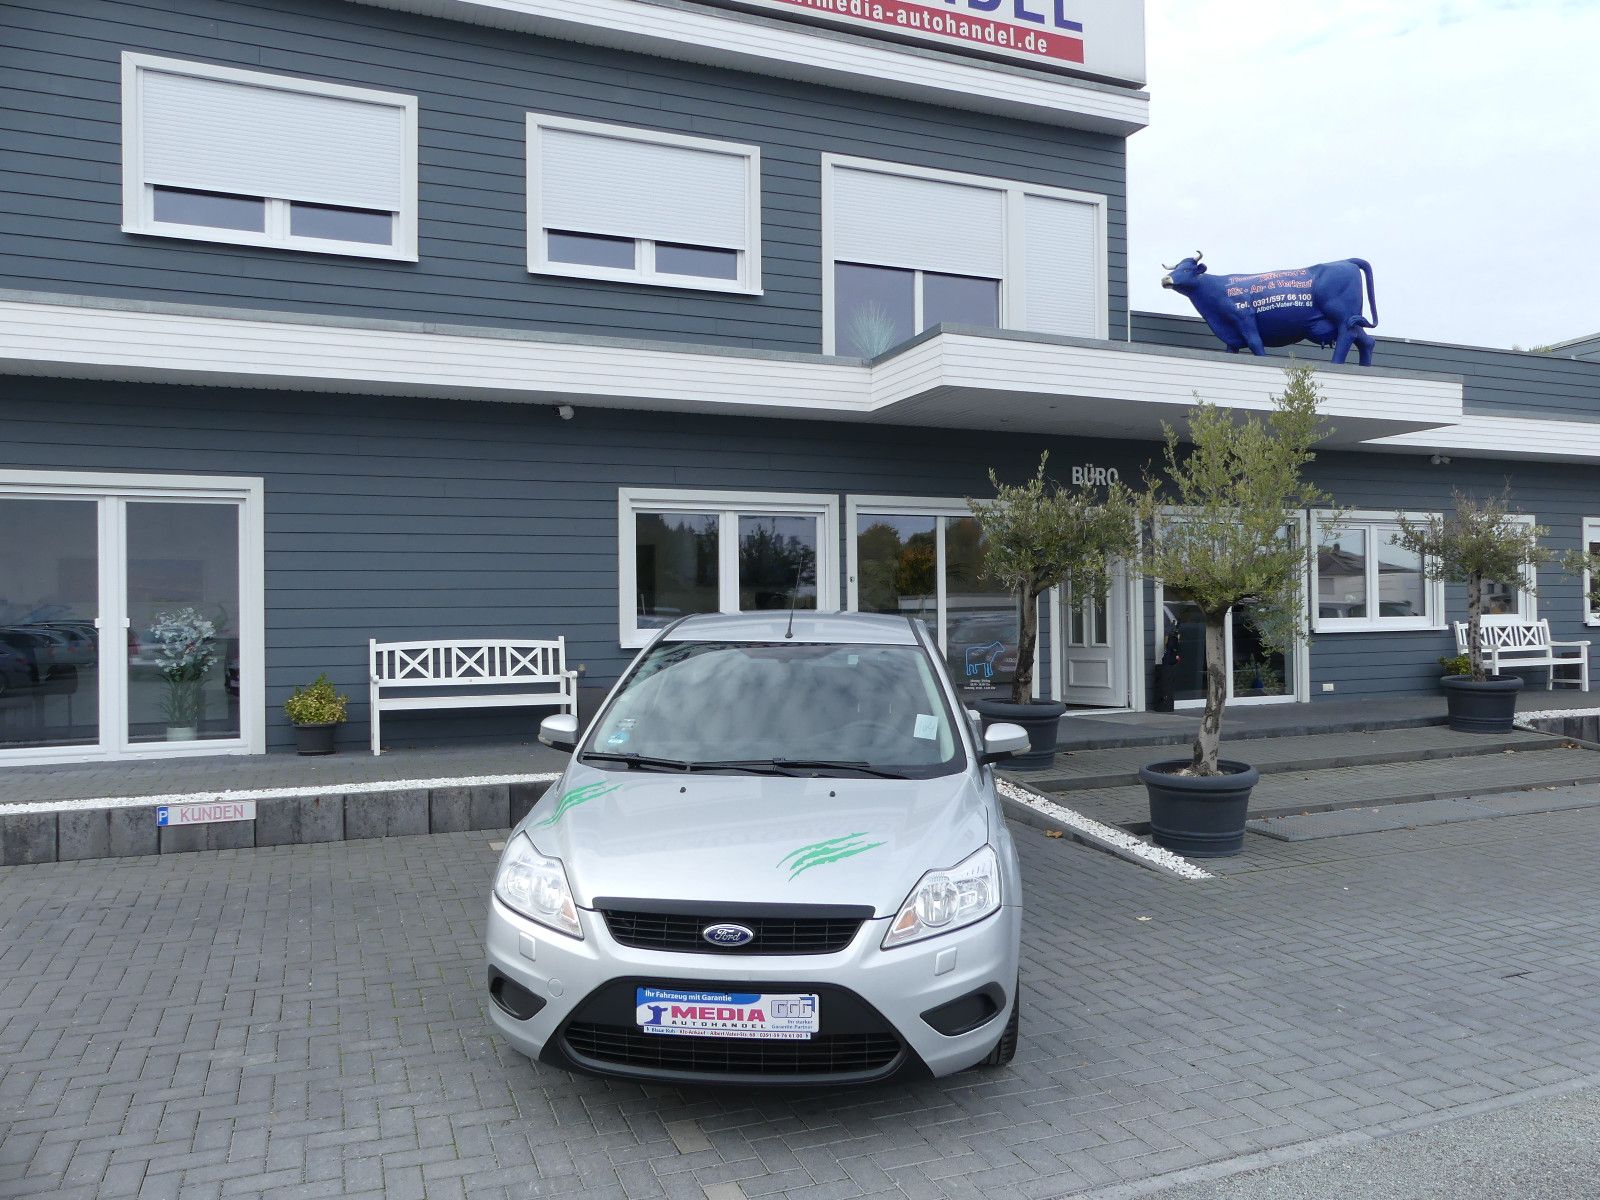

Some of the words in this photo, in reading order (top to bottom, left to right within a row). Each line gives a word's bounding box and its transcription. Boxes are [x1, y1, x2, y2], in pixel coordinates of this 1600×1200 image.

[1235, 301, 1250, 309] Tel.
[1298, 293, 1312, 301] 100
[1072, 463, 1119, 486] BÜRO
[159, 810, 168, 822] P
[180, 804, 244, 822] KUNDEN
[714, 928, 742, 941] Ford
[645, 989, 654, 997] Ihr
[655, 991, 687, 1001] Fahrzeug
[701, 994, 732, 1002] Garantie
[671, 1005, 766, 1023] MEDIA
[672, 1020, 766, 1029] AUTOHANDEL
